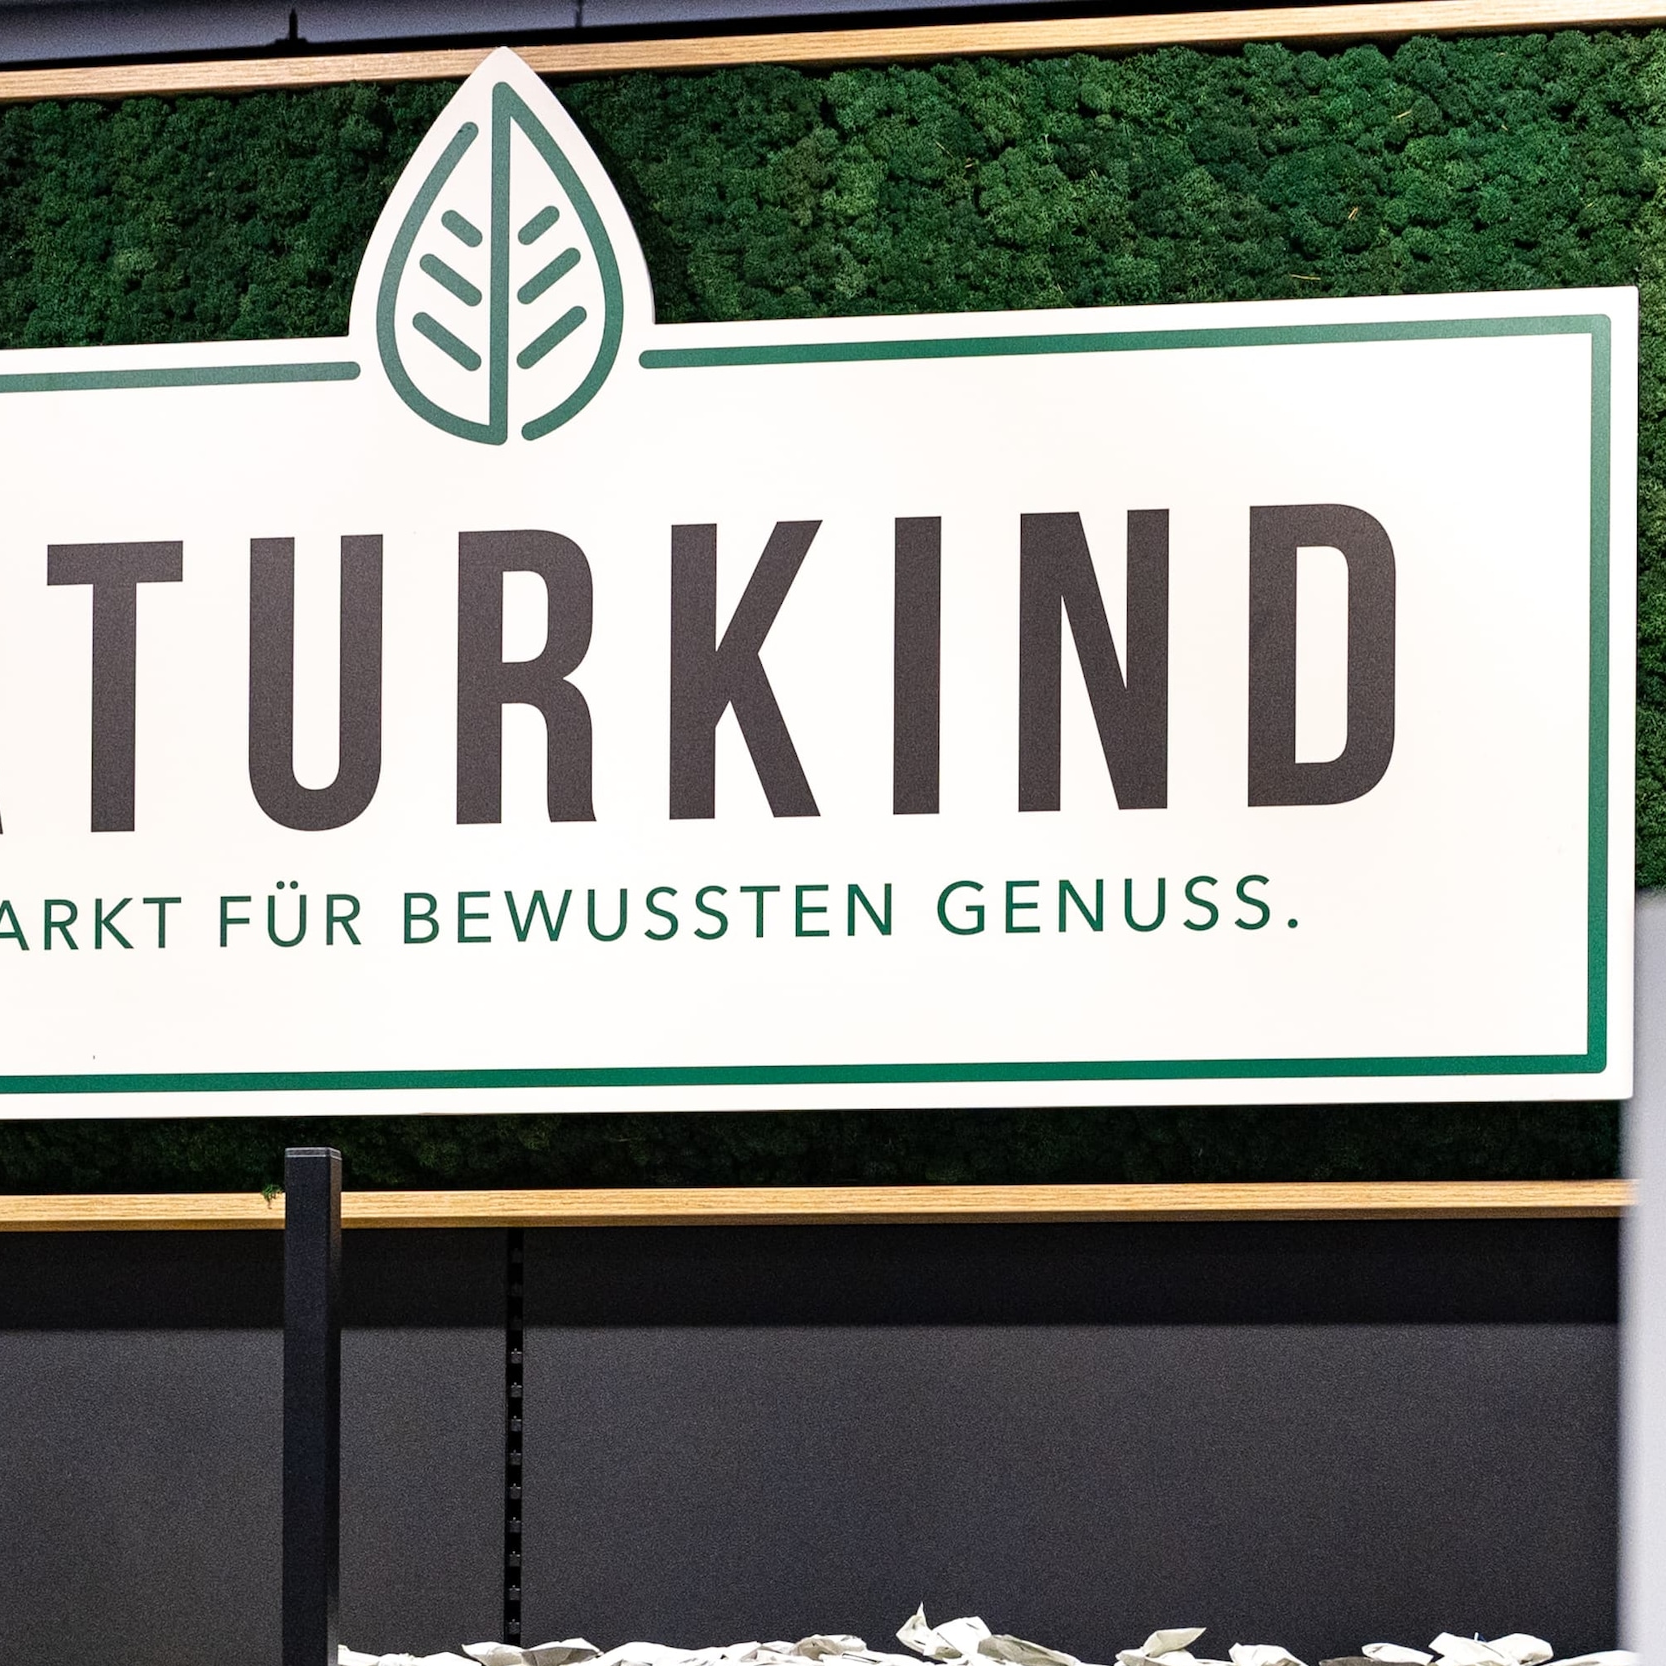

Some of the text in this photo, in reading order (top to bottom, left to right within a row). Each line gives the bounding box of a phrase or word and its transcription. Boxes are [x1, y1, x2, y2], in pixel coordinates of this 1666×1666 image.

[220, 879, 361, 948] FÜR
[404, 883, 892, 944] BEWUSSTEN
[937, 875, 1299, 935] GENUSS.
